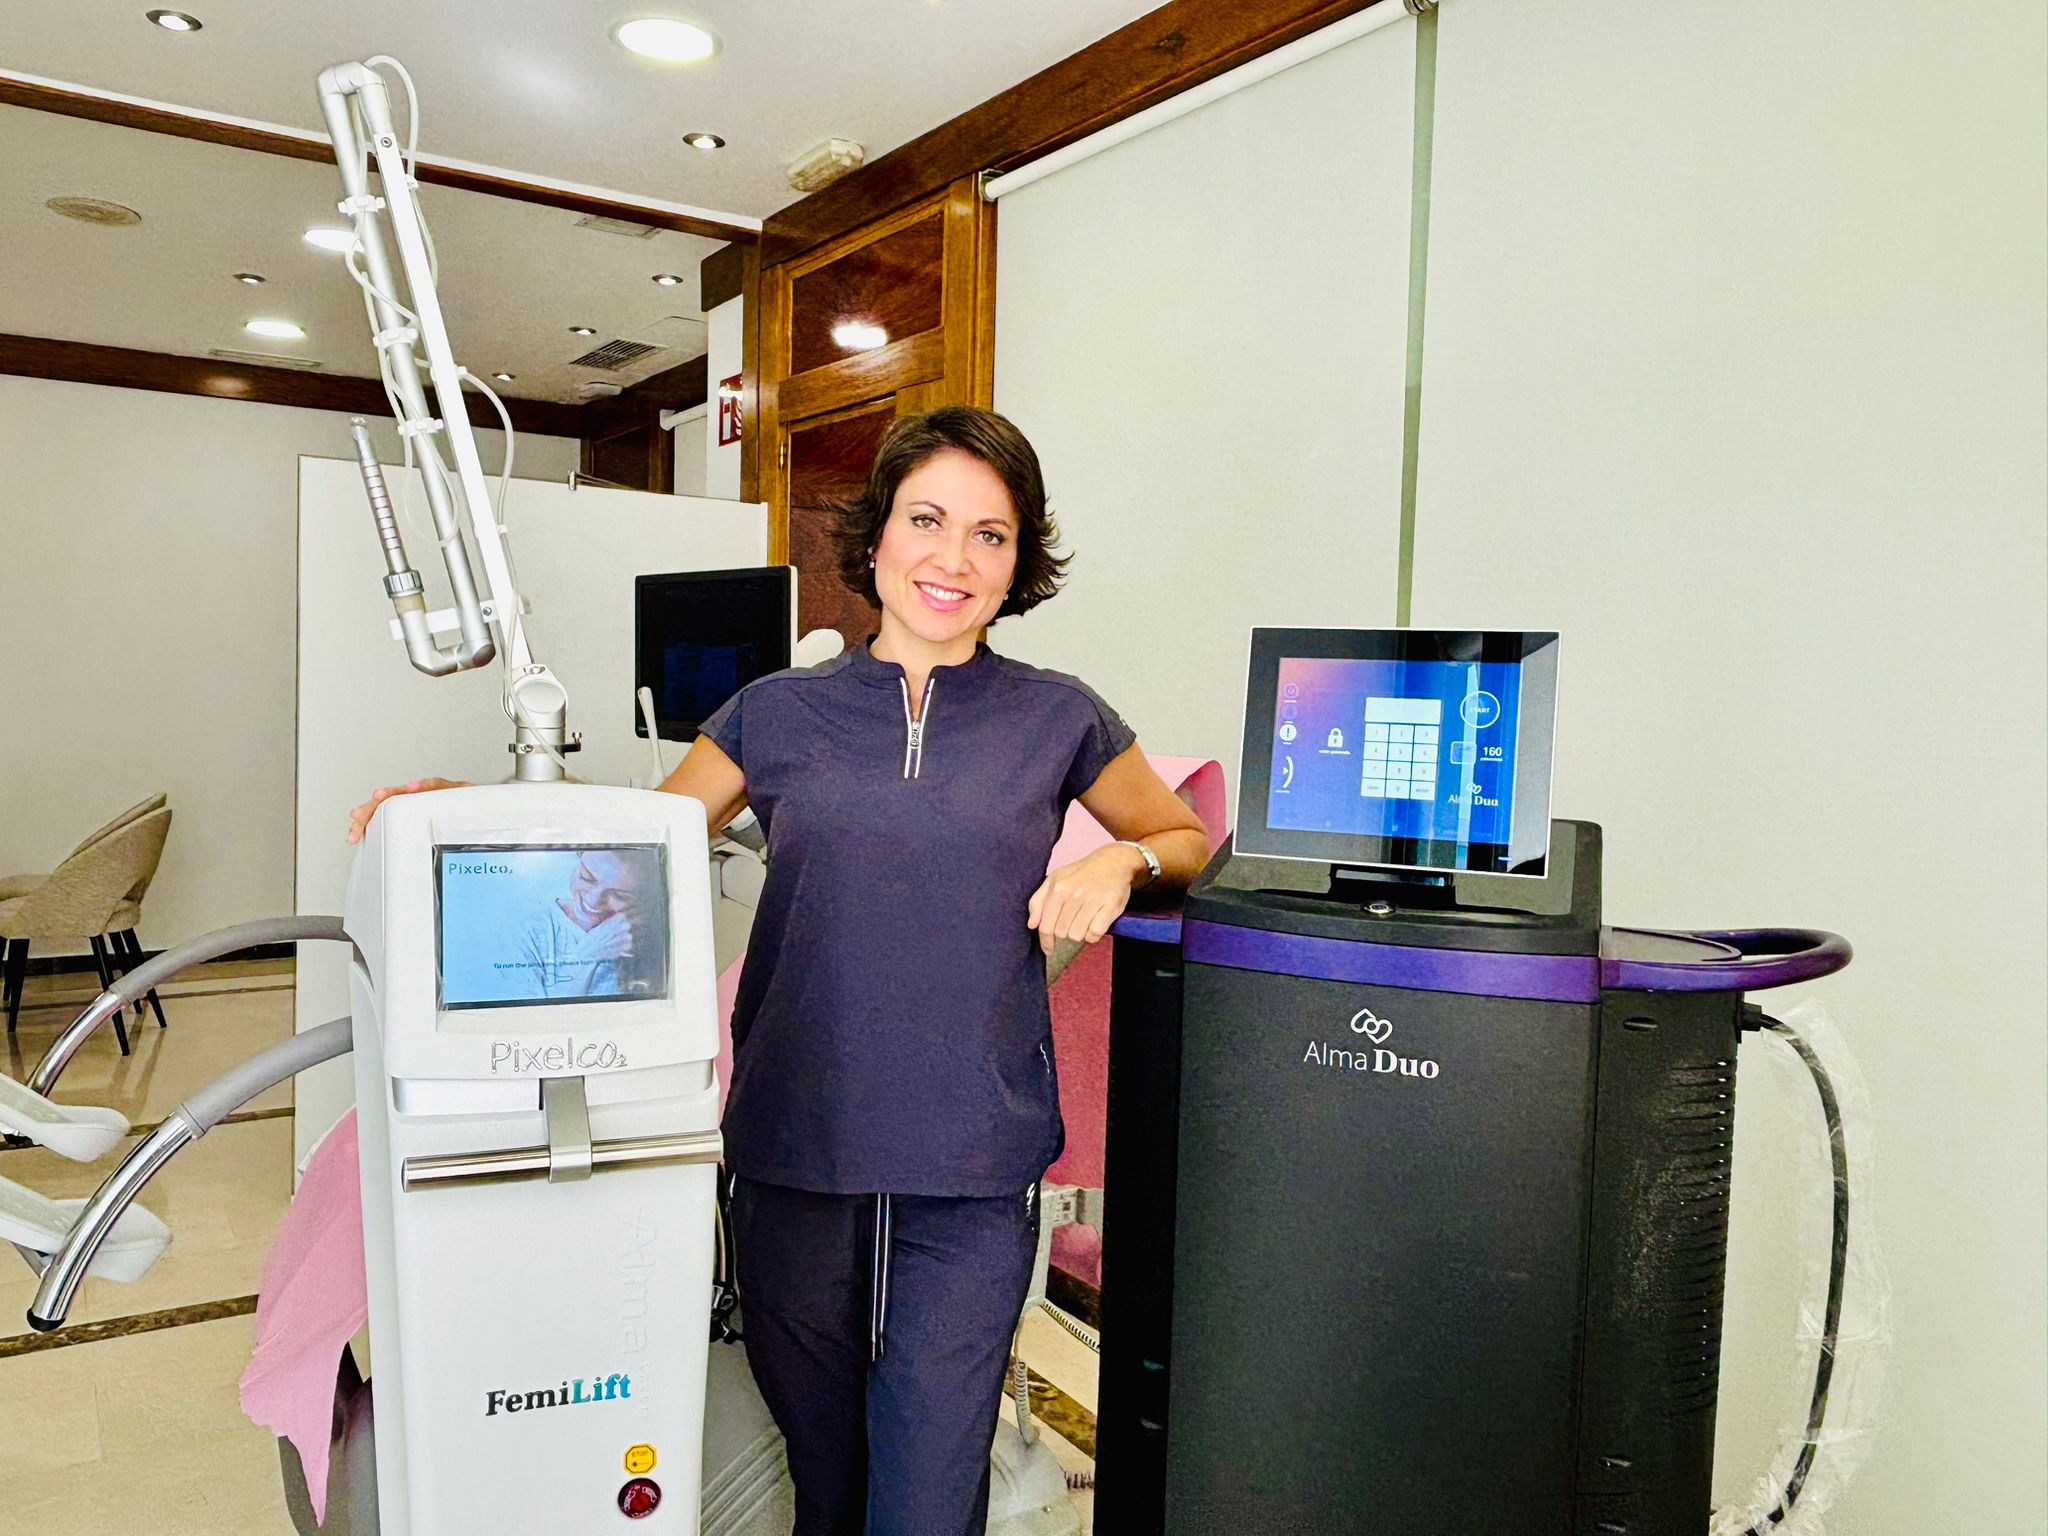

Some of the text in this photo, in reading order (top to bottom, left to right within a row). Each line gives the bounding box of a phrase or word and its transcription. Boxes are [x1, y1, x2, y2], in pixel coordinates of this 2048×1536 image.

[1483, 746, 1503, 757] 160
[1473, 795, 1499, 807] Duo
[1303, 1040, 1440, 1079] Alma Duo
[485, 1373, 632, 1417] FemiLift
